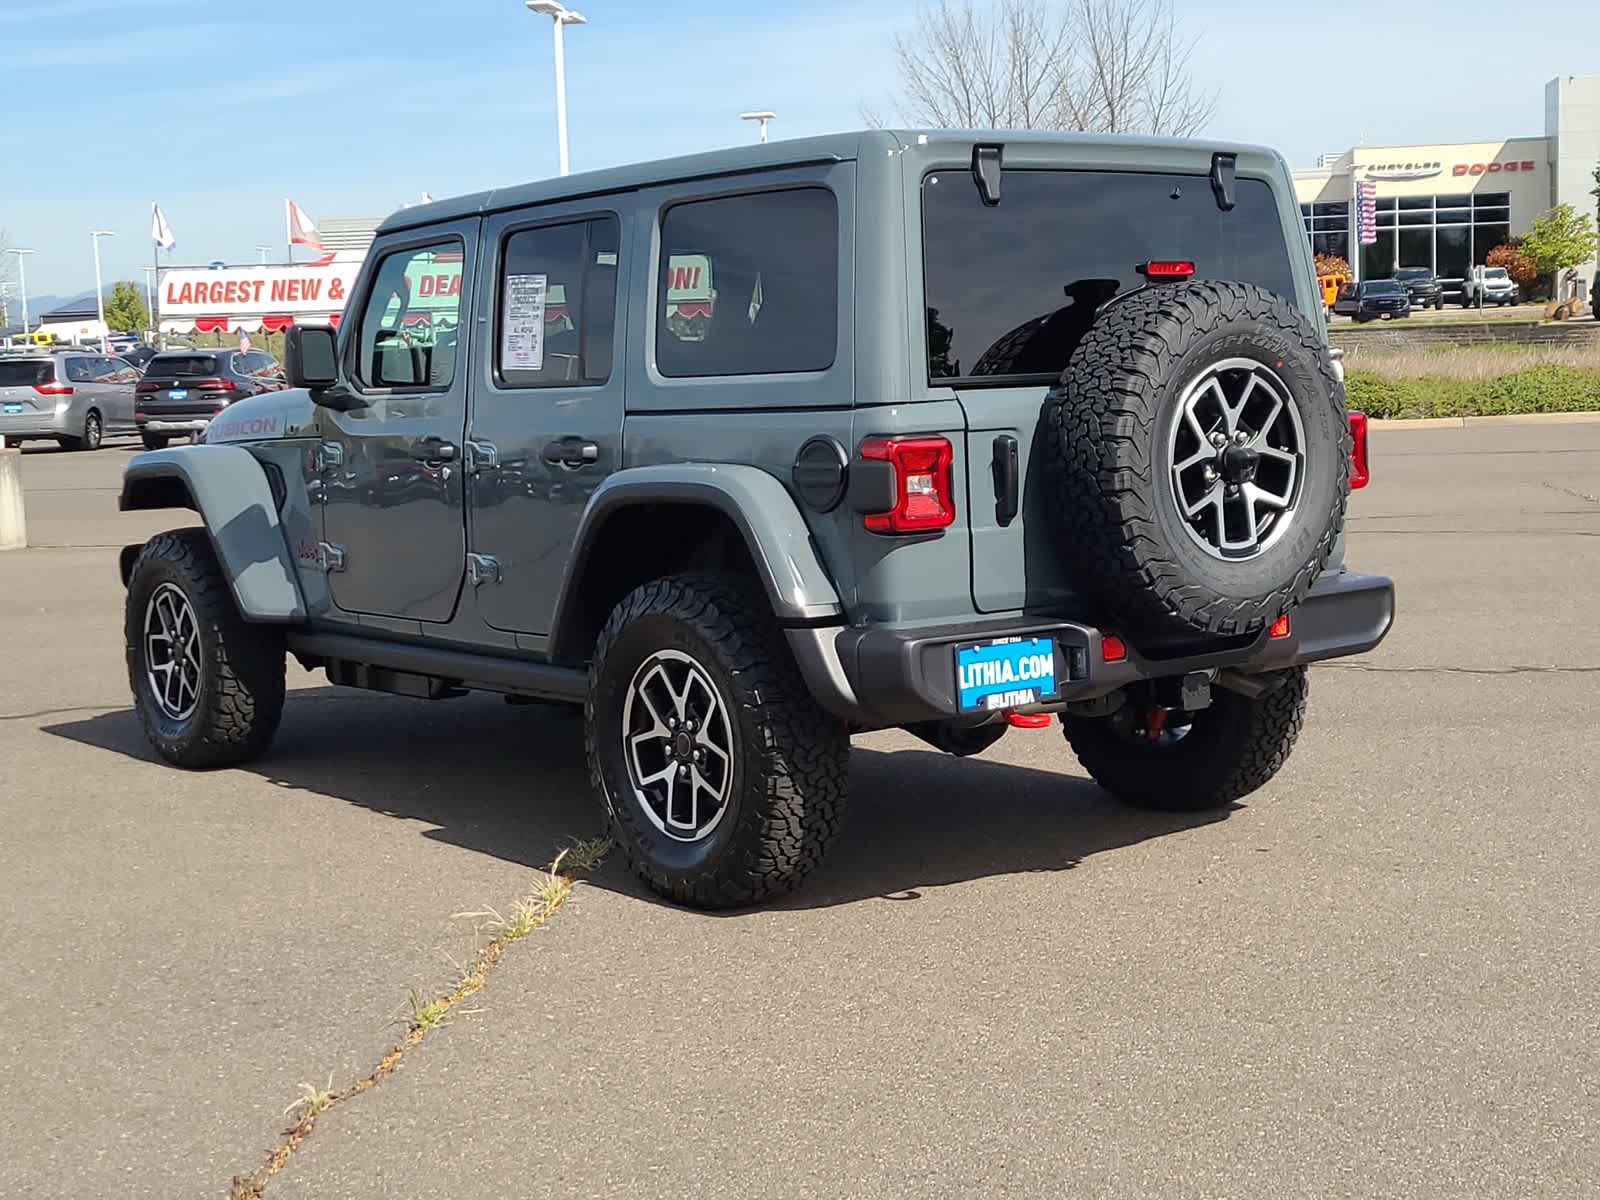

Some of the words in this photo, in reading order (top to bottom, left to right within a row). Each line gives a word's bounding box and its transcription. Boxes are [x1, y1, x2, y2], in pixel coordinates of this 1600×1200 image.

[1367, 162, 1441, 172] CHRYSLER
[1452, 161, 1535, 176] DODGE
[167, 280, 265, 304] LARGEST
[271, 278, 322, 301] NEW
[328, 277, 344, 300] &
[207, 416, 277, 438] RUBICON
[959, 652, 1054, 690] LITHIA.COM
[1000, 688, 1036, 708] LITHIA
